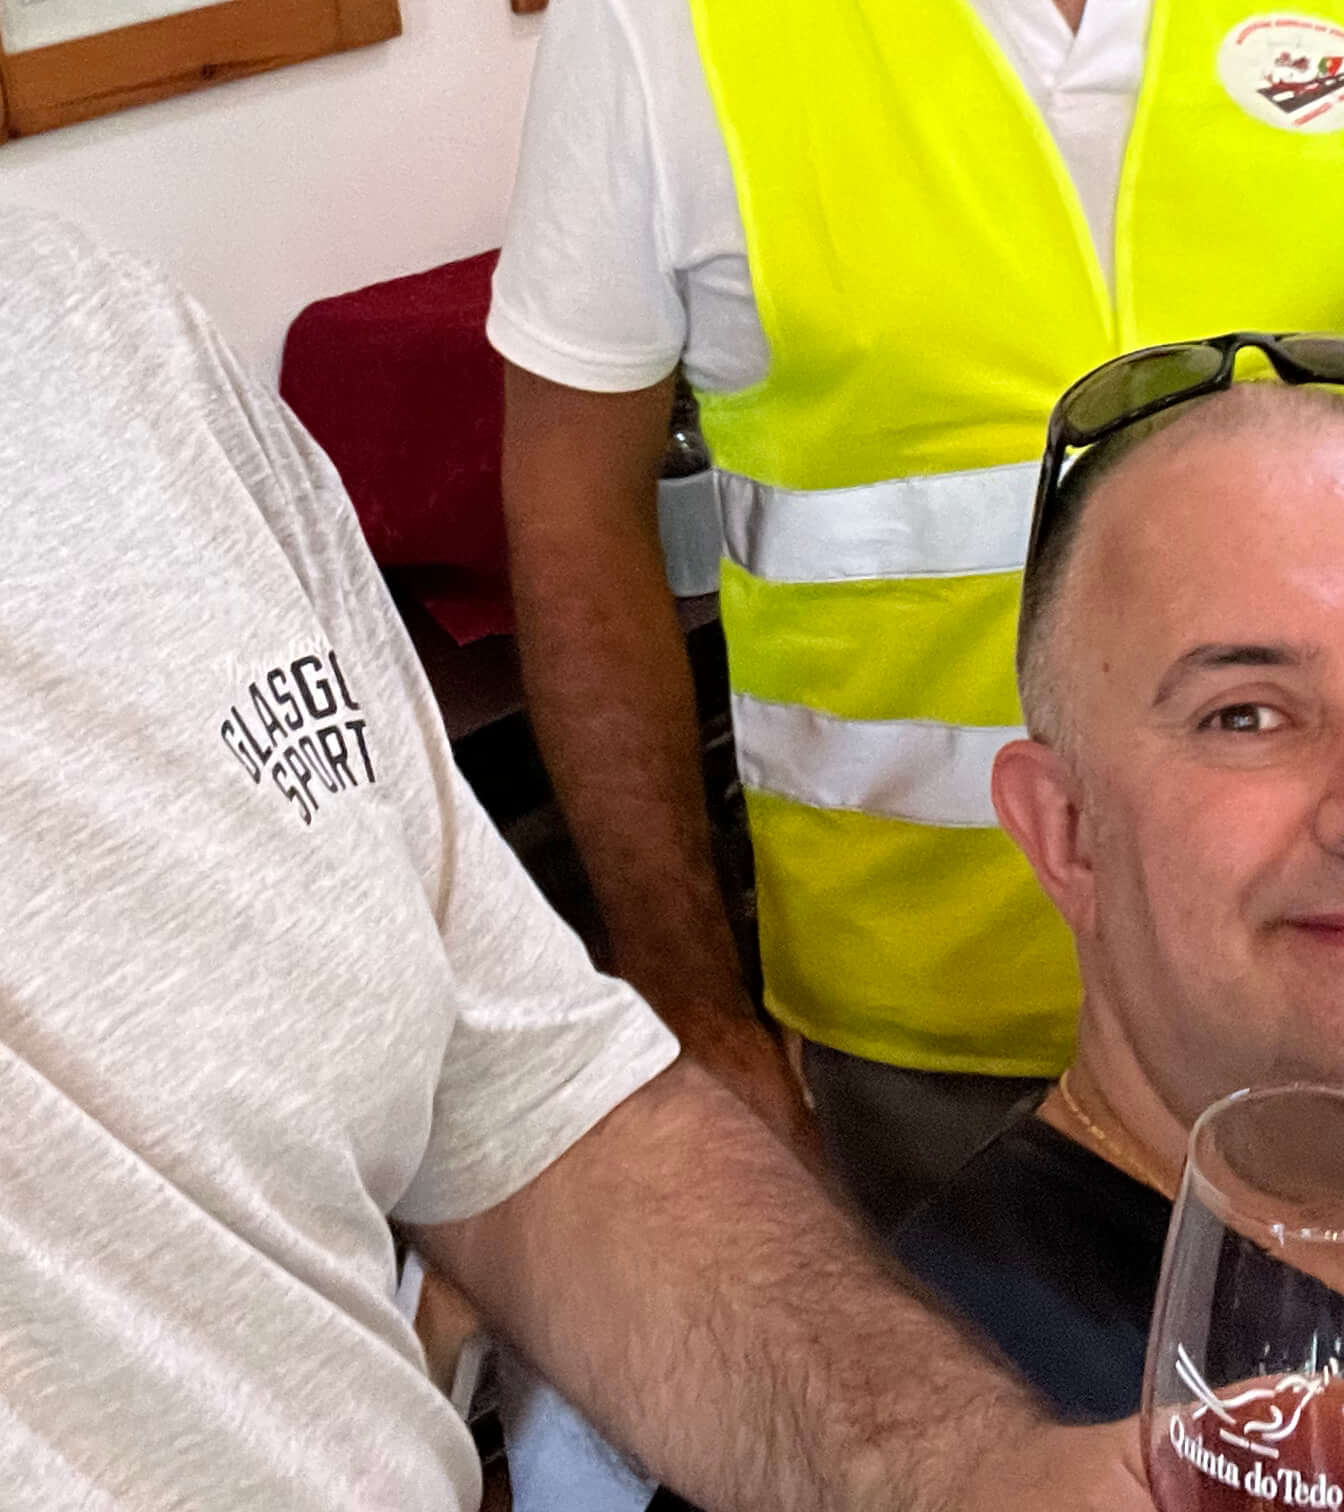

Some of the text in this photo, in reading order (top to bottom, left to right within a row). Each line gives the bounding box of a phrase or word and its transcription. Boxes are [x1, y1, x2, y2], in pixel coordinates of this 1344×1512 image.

[271, 718, 376, 826] SPORT
[1169, 1413, 1344, 1510] Quinta do Tedo
